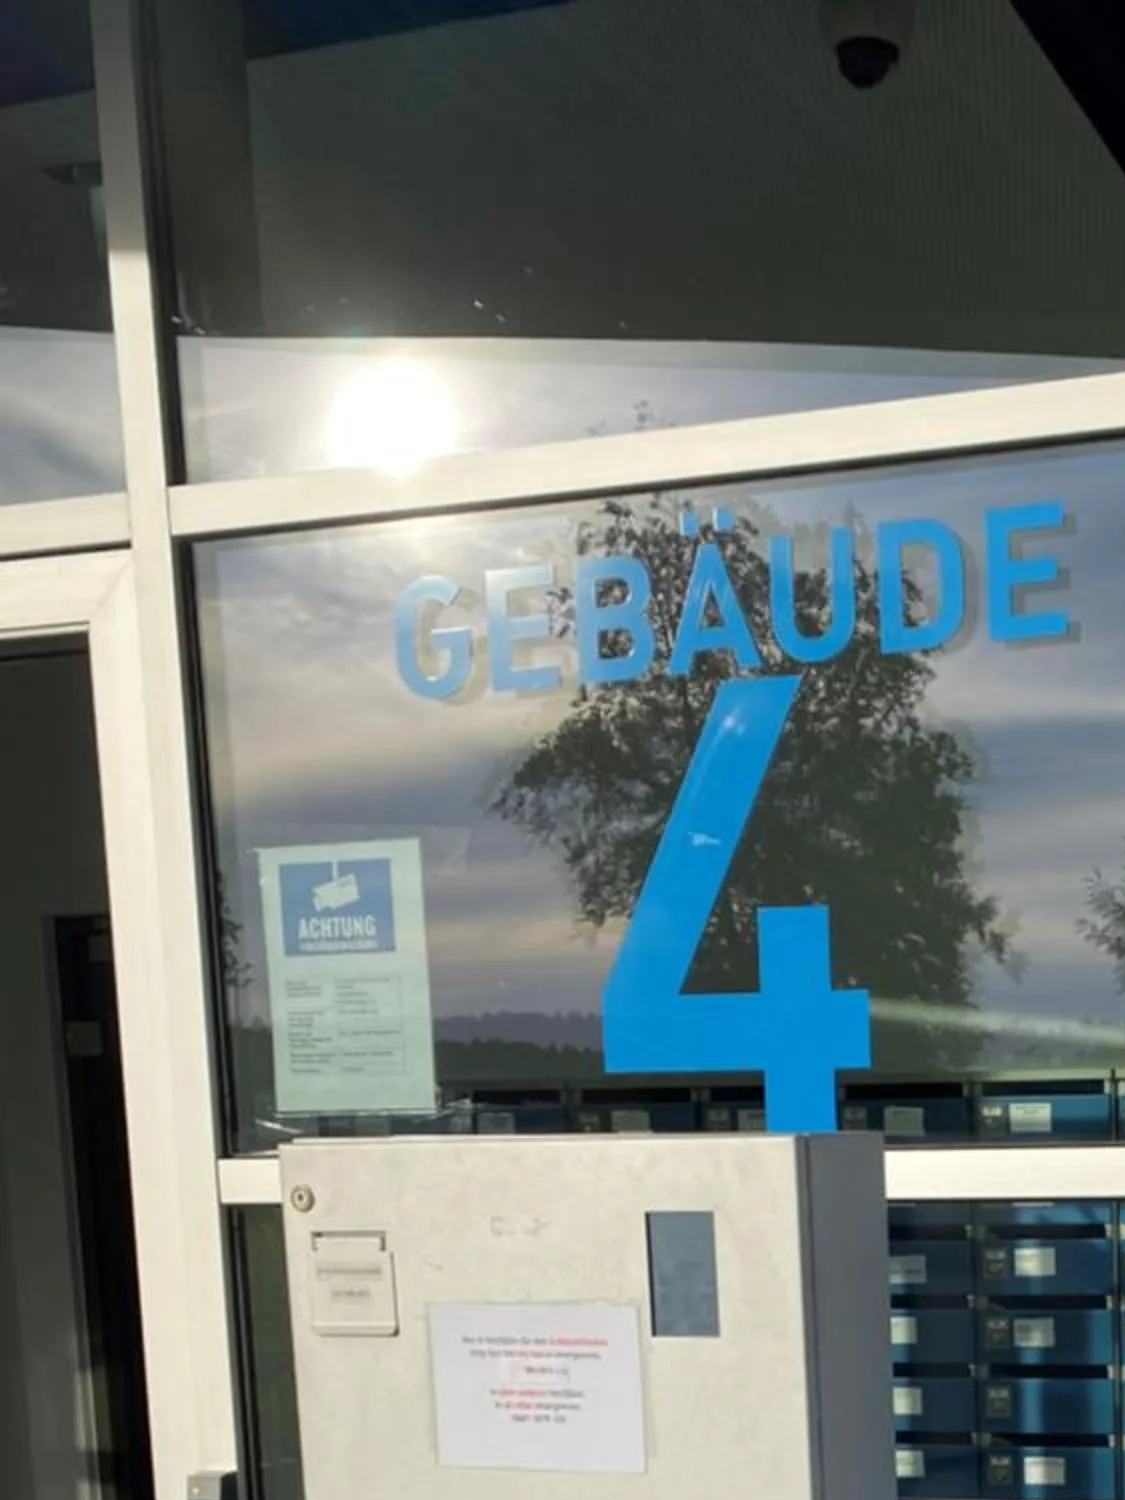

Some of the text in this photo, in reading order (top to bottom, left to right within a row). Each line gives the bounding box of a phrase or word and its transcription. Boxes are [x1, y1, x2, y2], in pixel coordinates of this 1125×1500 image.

[395, 503, 1069, 700] GEBÄUDE
[298, 915, 377, 939] ACHTUNG
[602, 674, 872, 1133] 4
